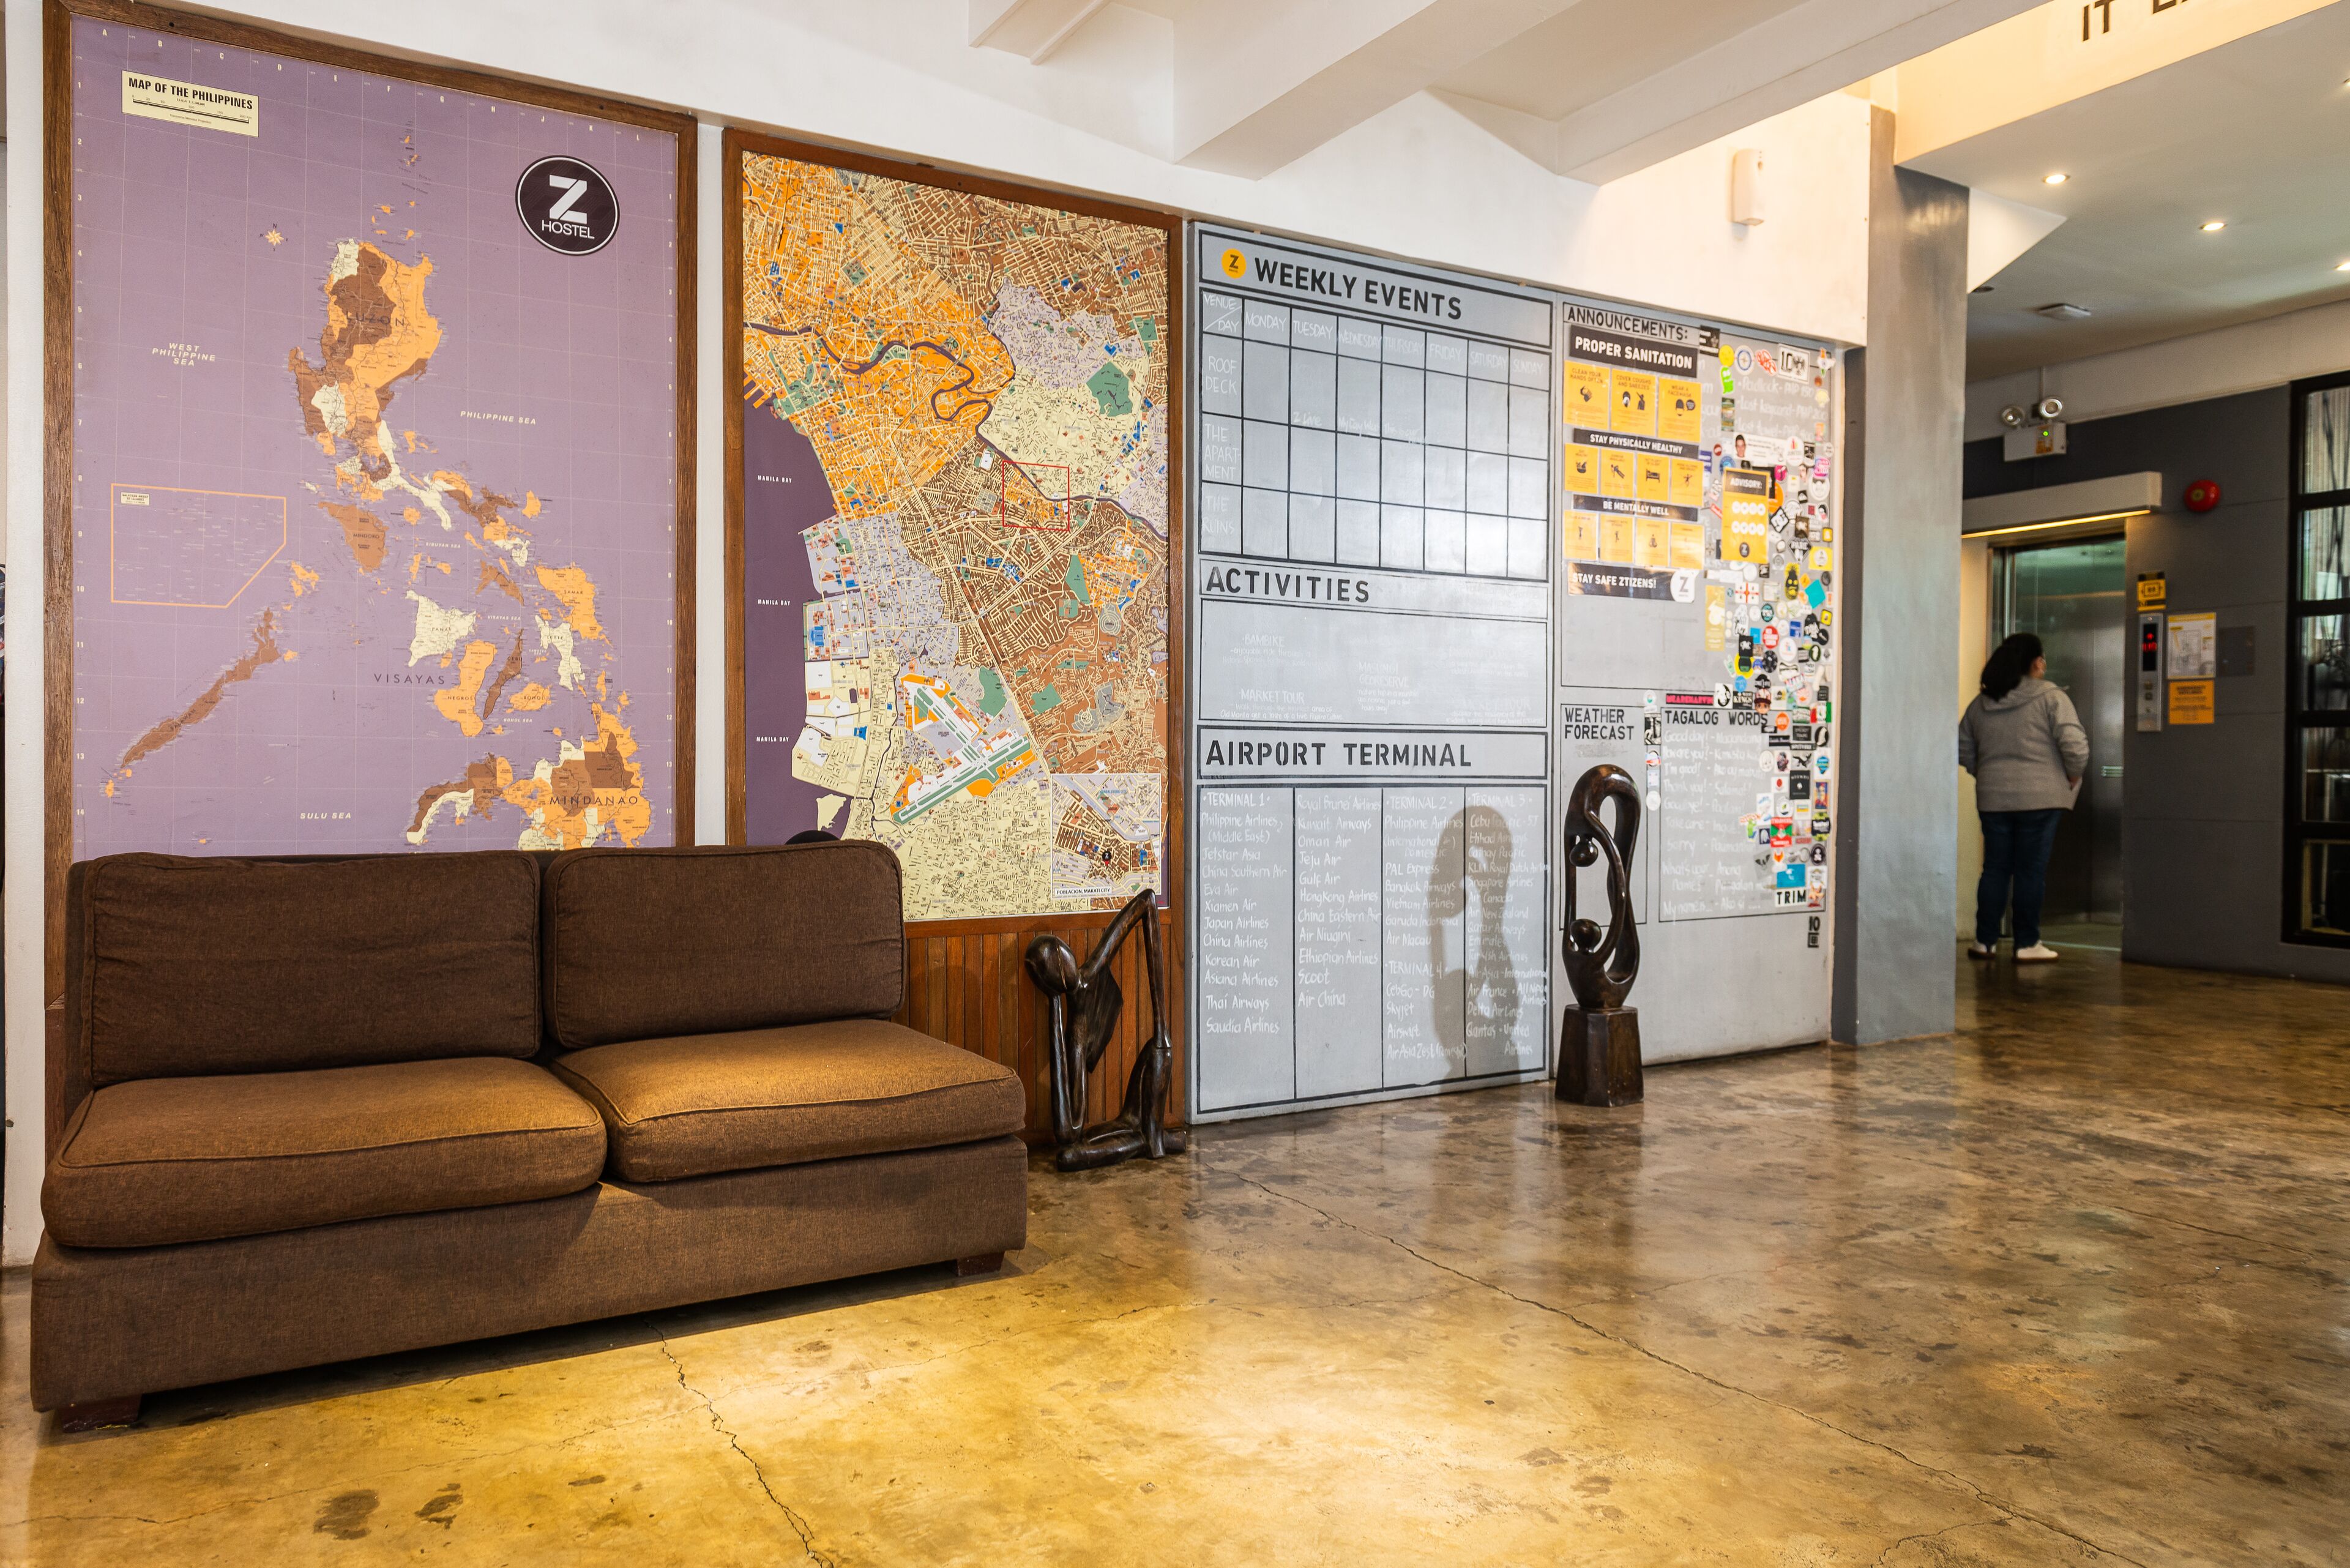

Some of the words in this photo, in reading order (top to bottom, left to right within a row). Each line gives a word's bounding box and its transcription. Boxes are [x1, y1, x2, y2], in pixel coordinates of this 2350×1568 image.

[2082, 0, 2114, 41] IT
[129, 77, 151, 90] MAP
[155, 83, 167, 92] OF
[171, 85, 188, 98] THE
[193, 89, 253, 109] PHILIPPINES
[550, 175, 587, 224] Z
[542, 220, 594, 239] HOSTEL
[1229, 255, 1238, 269] Z
[1255, 258, 1357, 299] WEEKLY
[1365, 280, 1461, 319] EVENTS
[1204, 294, 1237, 310] VENUE
[346, 311, 405, 326] LUZON
[1218, 319, 1239, 333] DAY
[1245, 312, 1286, 329] MONDAY
[1567, 307, 1688, 340] ANNOUNCEMENTS:
[1294, 320, 1333, 339] TUESDAY
[170, 343, 200, 351] WEST
[1338, 329, 1382, 349] WEDNESDAY
[1384, 335, 1423, 354] THURSDAY
[152, 348, 216, 362] PHILIPPINE
[1430, 343, 1462, 363] FRIDAY
[1471, 351, 1507, 370] SATURDAY
[1575, 336, 1621, 358] PROPER
[1625, 346, 1692, 369] SANITATION
[173, 357, 195, 366] SEA
[1209, 356, 1237, 374] ROOF
[1512, 358, 1543, 375] SUNDAY
[1206, 377, 1237, 395] DECK
[460, 411, 514, 422] PHILIPPINE
[1205, 424, 1229, 441] THE
[1590, 434, 1608, 443] STAY
[1609, 436, 1651, 449] PHYSICALLY
[1652, 444, 1683, 454] HEALTHY
[1206, 466, 1236, 480] MENT
[1206, 495, 1229, 512] THE
[1614, 502, 1649, 513] MENTALLY
[1651, 506, 1669, 515] WELL
[1202, 518, 1235, 534] RUINS
[1206, 566, 1368, 603] ACTIVITIES
[1572, 572, 1592, 584] STAY
[1595, 574, 1617, 586] SAFE
[1619, 576, 1656, 588] ZTIZENS!
[1679, 577, 1689, 592] Z
[374, 674, 445, 684] VISAYAS
[1240, 689, 1279, 702] MARKET
[1282, 691, 1305, 704] TOUR
[1565, 708, 1624, 723] WEATHER
[1665, 711, 1718, 725] TAGALOG
[1729, 712, 1767, 725] WORDS
[1565, 725, 1634, 740] FORECAST
[1206, 739, 1326, 766] AIRPORT
[1344, 743, 1471, 767] TERMINAL
[550, 796, 638, 805] MINDANAO
[1207, 792, 1256, 807] TERMINAL
[1390, 796, 1438, 810] TERMINAL
[1439, 796, 1447, 809] 2
[1472, 793, 1515, 807] TERMINAL
[1201, 812, 1243, 828] Philippine
[1245, 813, 1277, 826] Airlines
[1298, 815, 1330, 831] Kuwait
[1336, 816, 1371, 834] Airways
[1384, 815, 1427, 832] Philippine
[1431, 815, 1463, 829] Airlines
[1471, 814, 1490, 827] Cebu
[1208, 830, 1242, 842] (Middle
[1245, 829, 1270, 844] East)
[1298, 835, 1329, 847] Oman
[1335, 834, 1351, 848] Air
[1203, 846, 1238, 861] Jetstar
[1242, 848, 1260, 861] Asia
[1299, 851, 1319, 871] Jeju
[1324, 851, 1341, 867] Air
[1203, 864, 1228, 878] China
[1273, 864, 1287, 878] Air
[1386, 862, 1403, 876] PAL
[1407, 863, 1439, 877] Express
[1299, 871, 1321, 887] Gulf
[1324, 871, 1340, 885] Air
[1204, 883, 1220, 896] Eva
[1224, 883, 1239, 896] Air
[1348, 889, 1378, 903] Airlines
[1386, 879, 1422, 897] Bangkok
[1423, 880, 1455, 895] Airways
[1204, 899, 1238, 912] Xiamen
[1242, 898, 1256, 912] Air
[1387, 897, 1420, 909] Vietnam
[1422, 896, 1455, 909] Airlines
[1469, 892, 1480, 902] Air
[1777, 890, 1806, 904] TRIM
[1298, 908, 1324, 922] China
[1329, 908, 1364, 923] Eastern
[1367, 906, 1381, 922] Air
[1386, 914, 1418, 927] Garuda
[1204, 917, 1233, 931] Japan
[1236, 916, 1269, 929] Airlines
[1203, 933, 1230, 947] China
[1234, 934, 1269, 949] Airlines
[1299, 927, 1314, 943] Air
[1317, 924, 1351, 948] Niugini
[1387, 930, 1400, 945] Air
[1403, 933, 1431, 946] Macau
[1206, 954, 1239, 968] Korean
[1243, 954, 1259, 968] Air
[1299, 947, 1344, 966] Ethiopian
[1346, 949, 1378, 965] Airlines
[1298, 968, 1330, 985] Scoot
[1389, 960, 1434, 977] TERMINAL
[1204, 969, 1237, 986] Asiana
[1242, 971, 1278, 987] Airlines
[1206, 993, 1228, 1010] Thai
[1232, 993, 1269, 1014] Airways
[1298, 990, 1315, 1007] Air
[1318, 988, 1345, 1007] China
[1387, 1001, 1414, 1021] Skyjet
[1206, 1017, 1241, 1033] Saudia
[1244, 1016, 1280, 1034] Airlines
